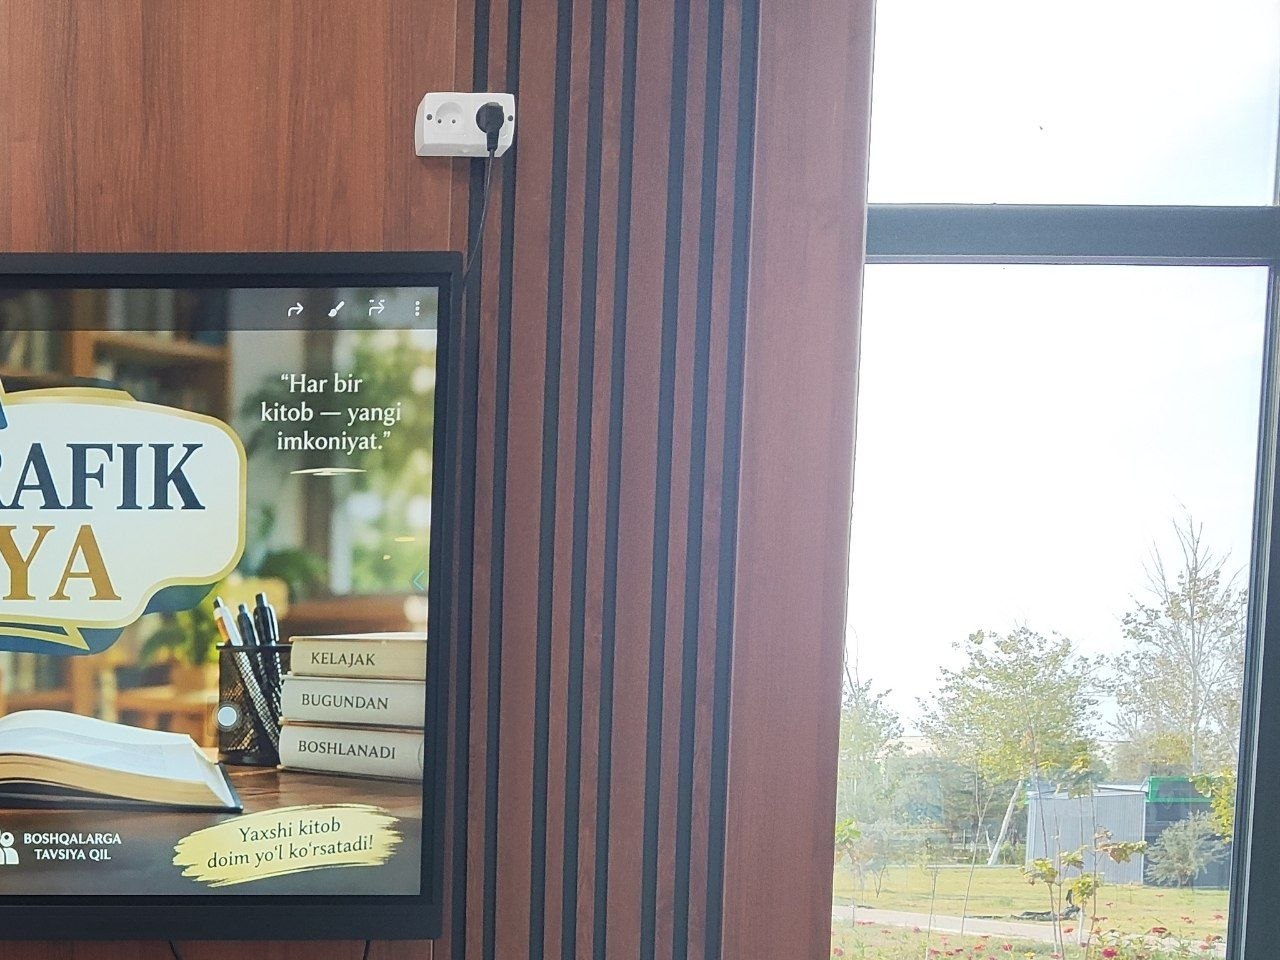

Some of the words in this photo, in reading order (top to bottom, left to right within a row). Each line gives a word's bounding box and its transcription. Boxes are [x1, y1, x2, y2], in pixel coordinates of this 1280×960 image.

[333, 373, 363, 393] bir
[260, 402, 314, 422] kitob
[346, 402, 402, 430] yangi
[310, 651, 376, 668] KELAJAK
[301, 693, 389, 710] BUGUNDAN
[298, 740, 396, 760] BOSHLANADI
[238, 822, 293, 843] Yaxshi
[298, 816, 341, 834] kitob
[23, 832, 122, 846] BOSHQALARGA
[34, 848, 86, 861] TAVSIYA
[89, 848, 112, 862] QIL
[207, 852, 250, 869] doim
